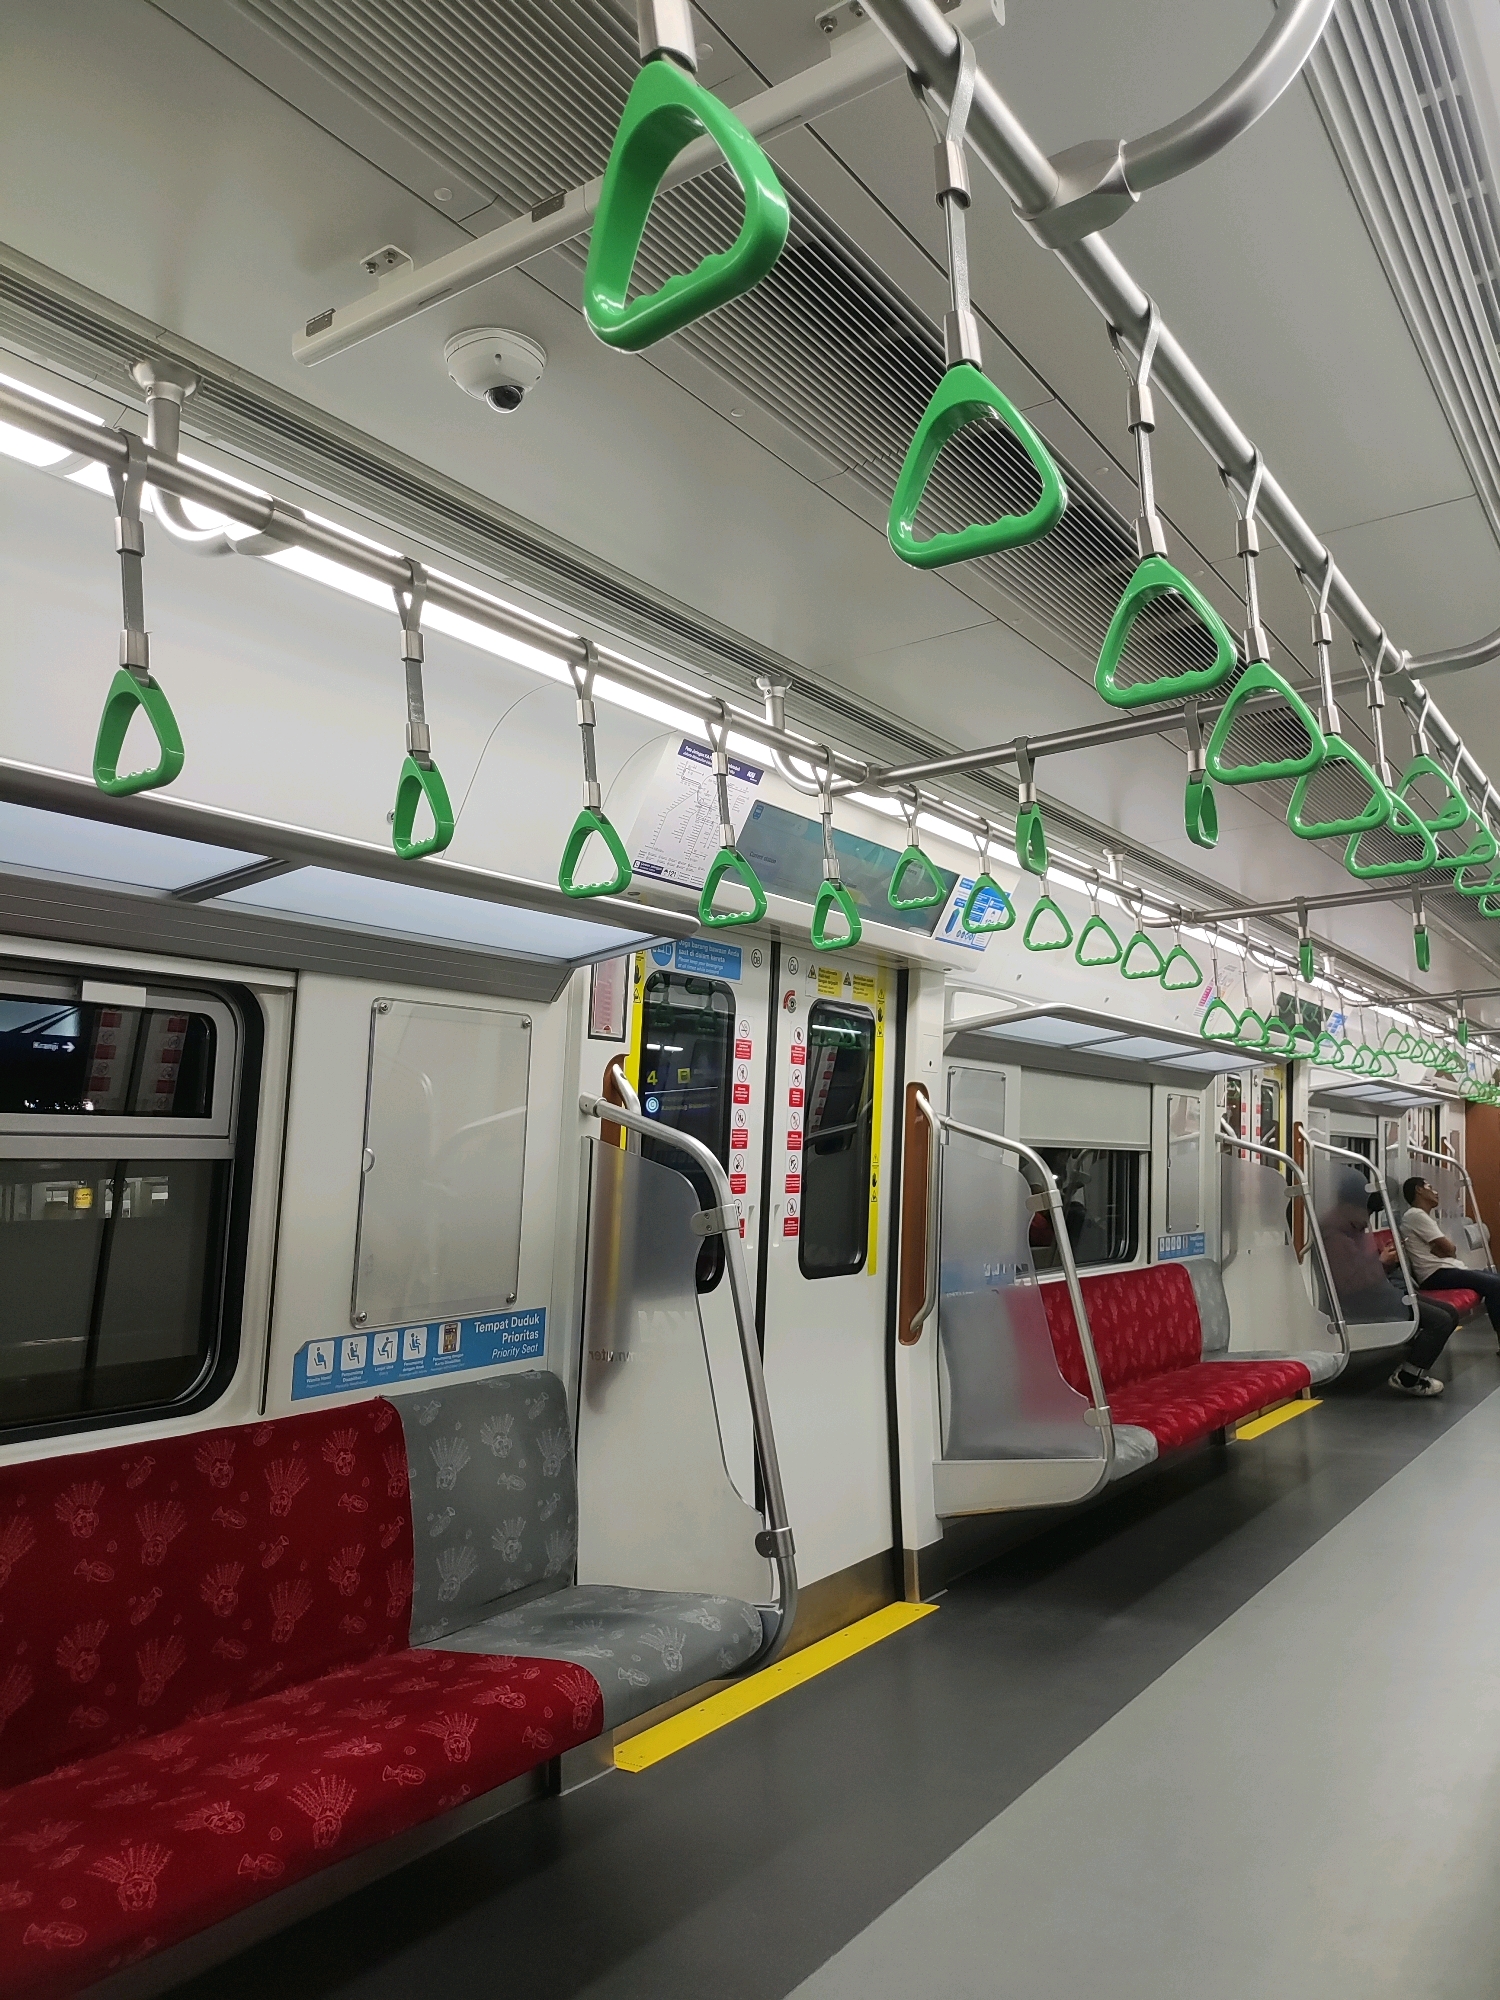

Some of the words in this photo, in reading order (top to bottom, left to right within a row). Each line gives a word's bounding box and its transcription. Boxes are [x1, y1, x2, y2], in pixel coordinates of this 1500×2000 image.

[668, 870, 677, 878] 121
[678, 948, 689, 956] saat
[695, 951, 710, 960] dalam
[679, 940, 691, 948] Jaga
[691, 941, 708, 952] barang
[727, 948, 740, 958] Anda
[754, 951, 761, 965] 6B
[647, 1070, 658, 1086] 4
[474, 1319, 509, 1334] Tempat
[511, 1313, 540, 1328] Duduk
[502, 1329, 539, 1344] Prioritas
[492, 1345, 520, 1359] Priority
[521, 1343, 539, 1355] Seat
